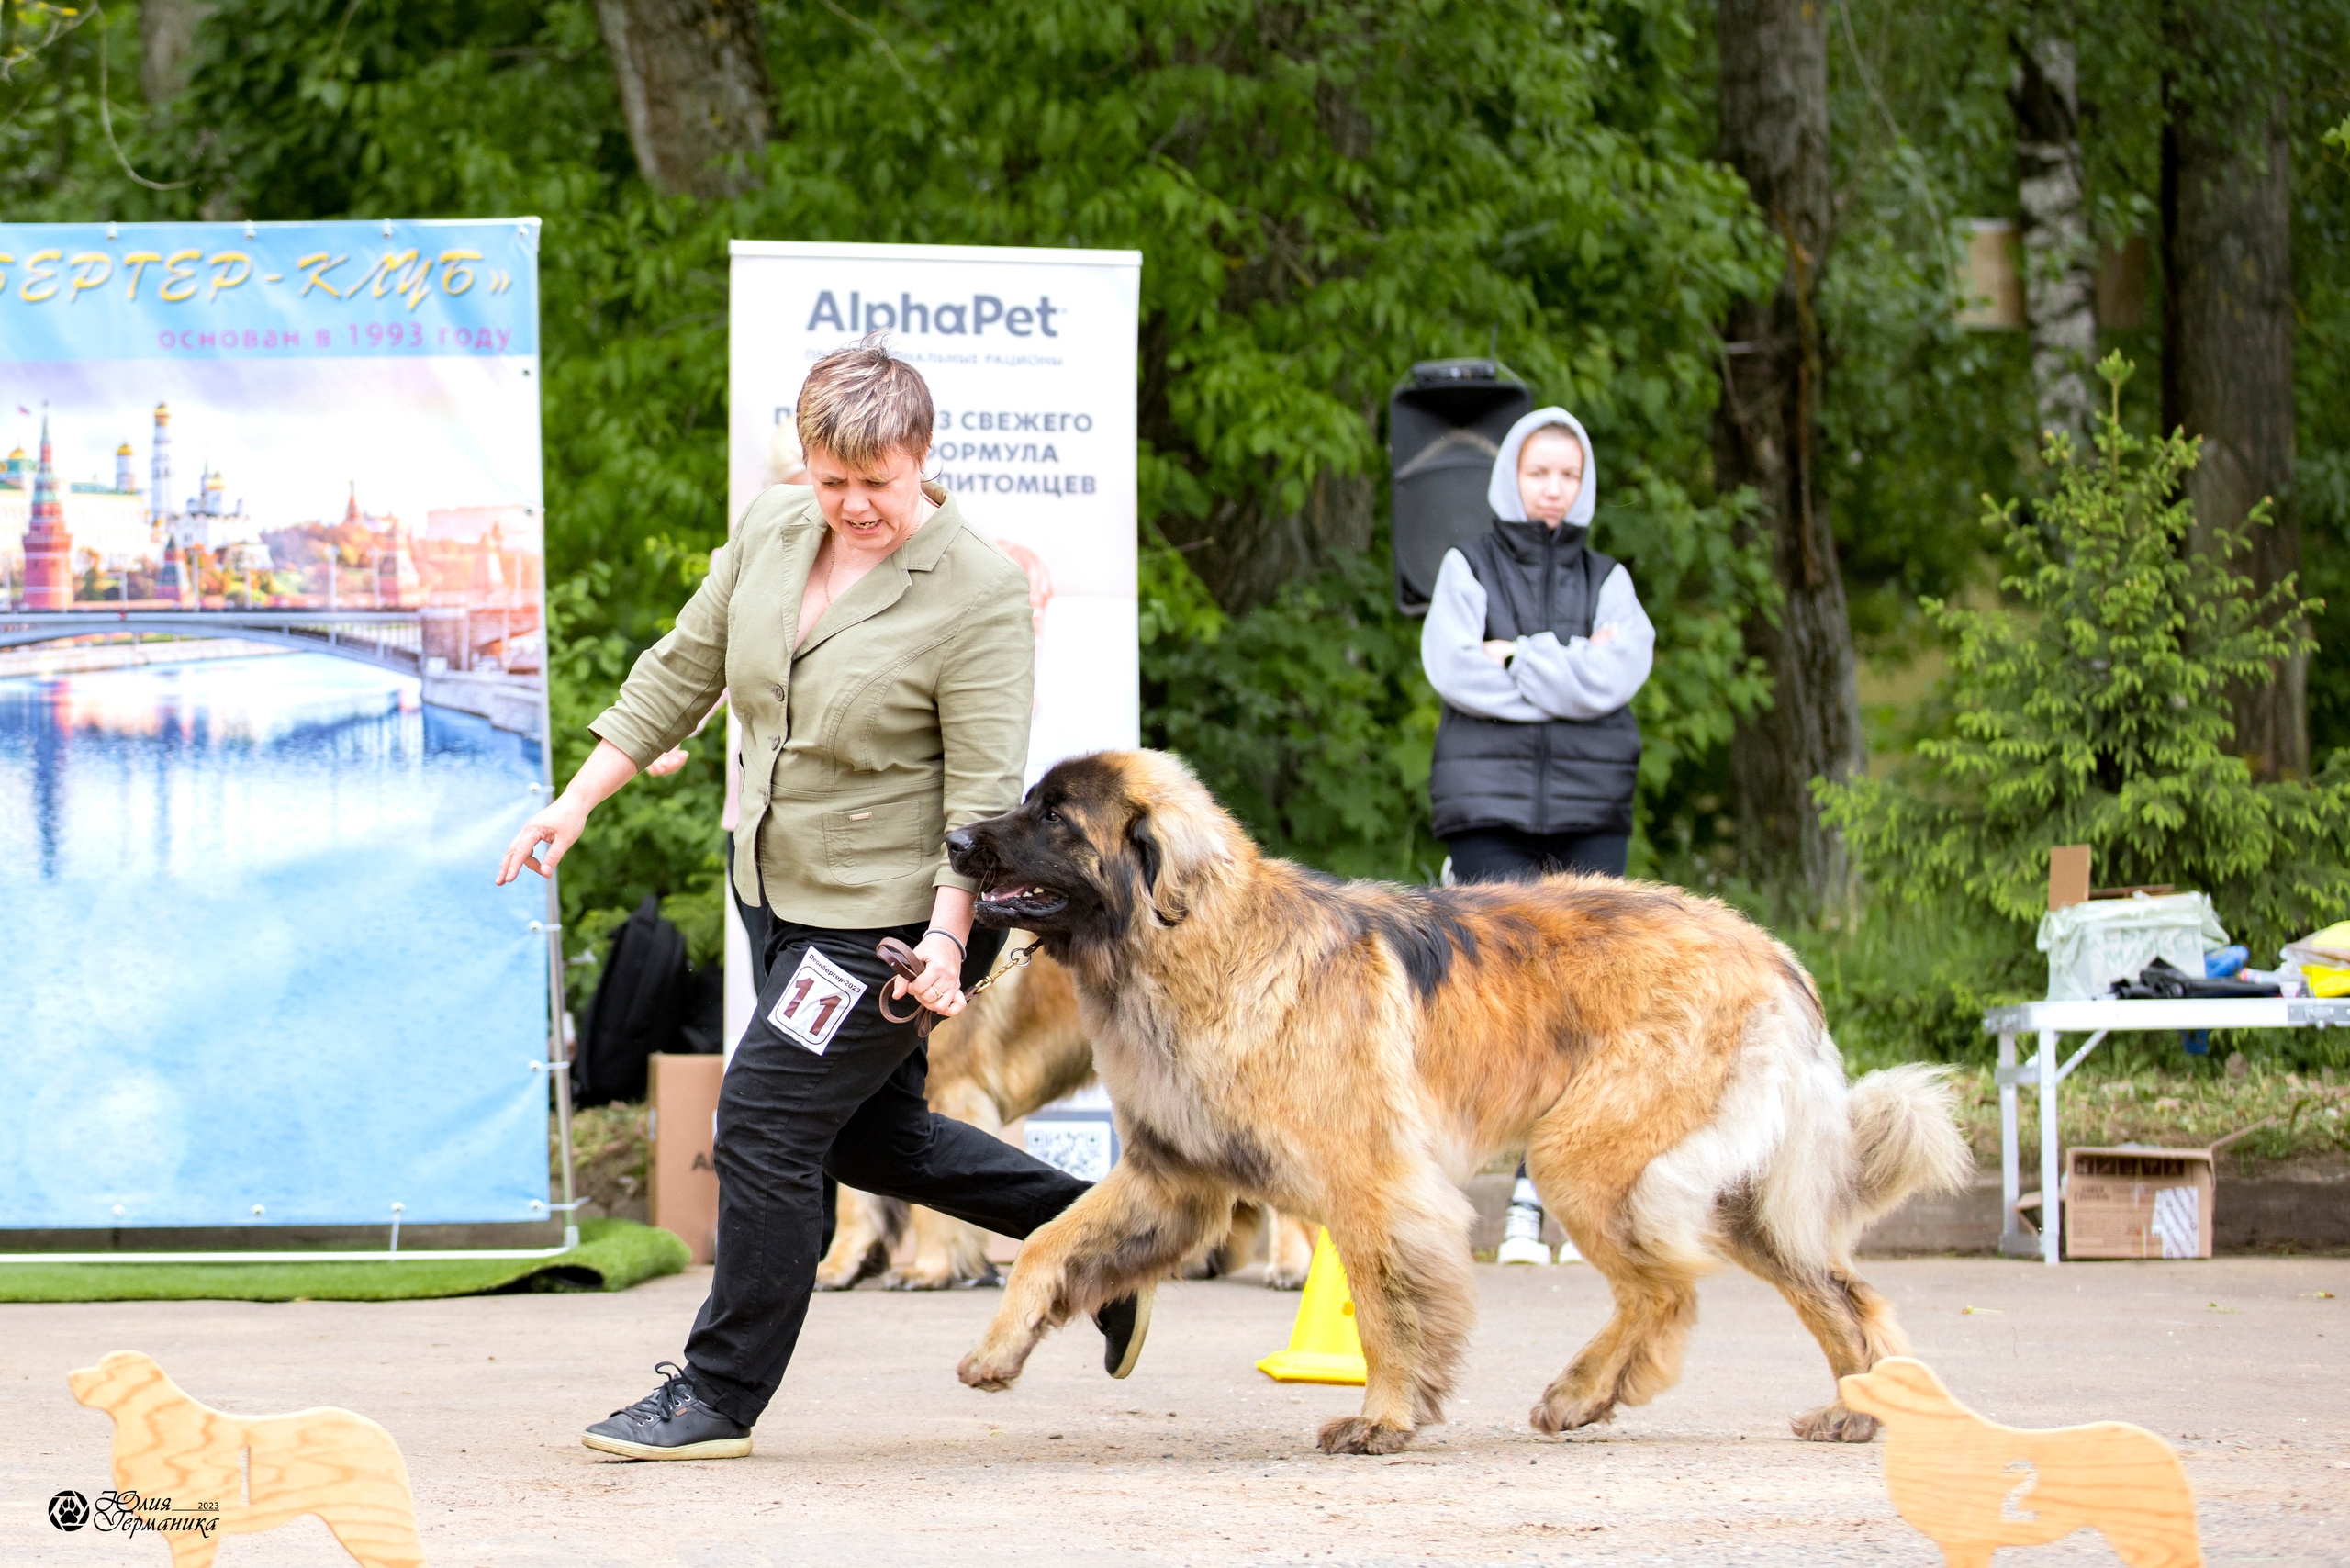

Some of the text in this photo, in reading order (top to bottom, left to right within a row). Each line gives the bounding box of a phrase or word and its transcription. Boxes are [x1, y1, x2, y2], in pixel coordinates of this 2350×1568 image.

[806, 290, 1058, 338] AlphaPet
[159, 321, 511, 352] основан в 1993 году
[961, 411, 1093, 432] СВЕЖЕГО
[937, 473, 1097, 498] ПИТОМЦЕВ
[808, 953, 861, 994] Леонбергер-2023
[783, 977, 843, 1036] 11
